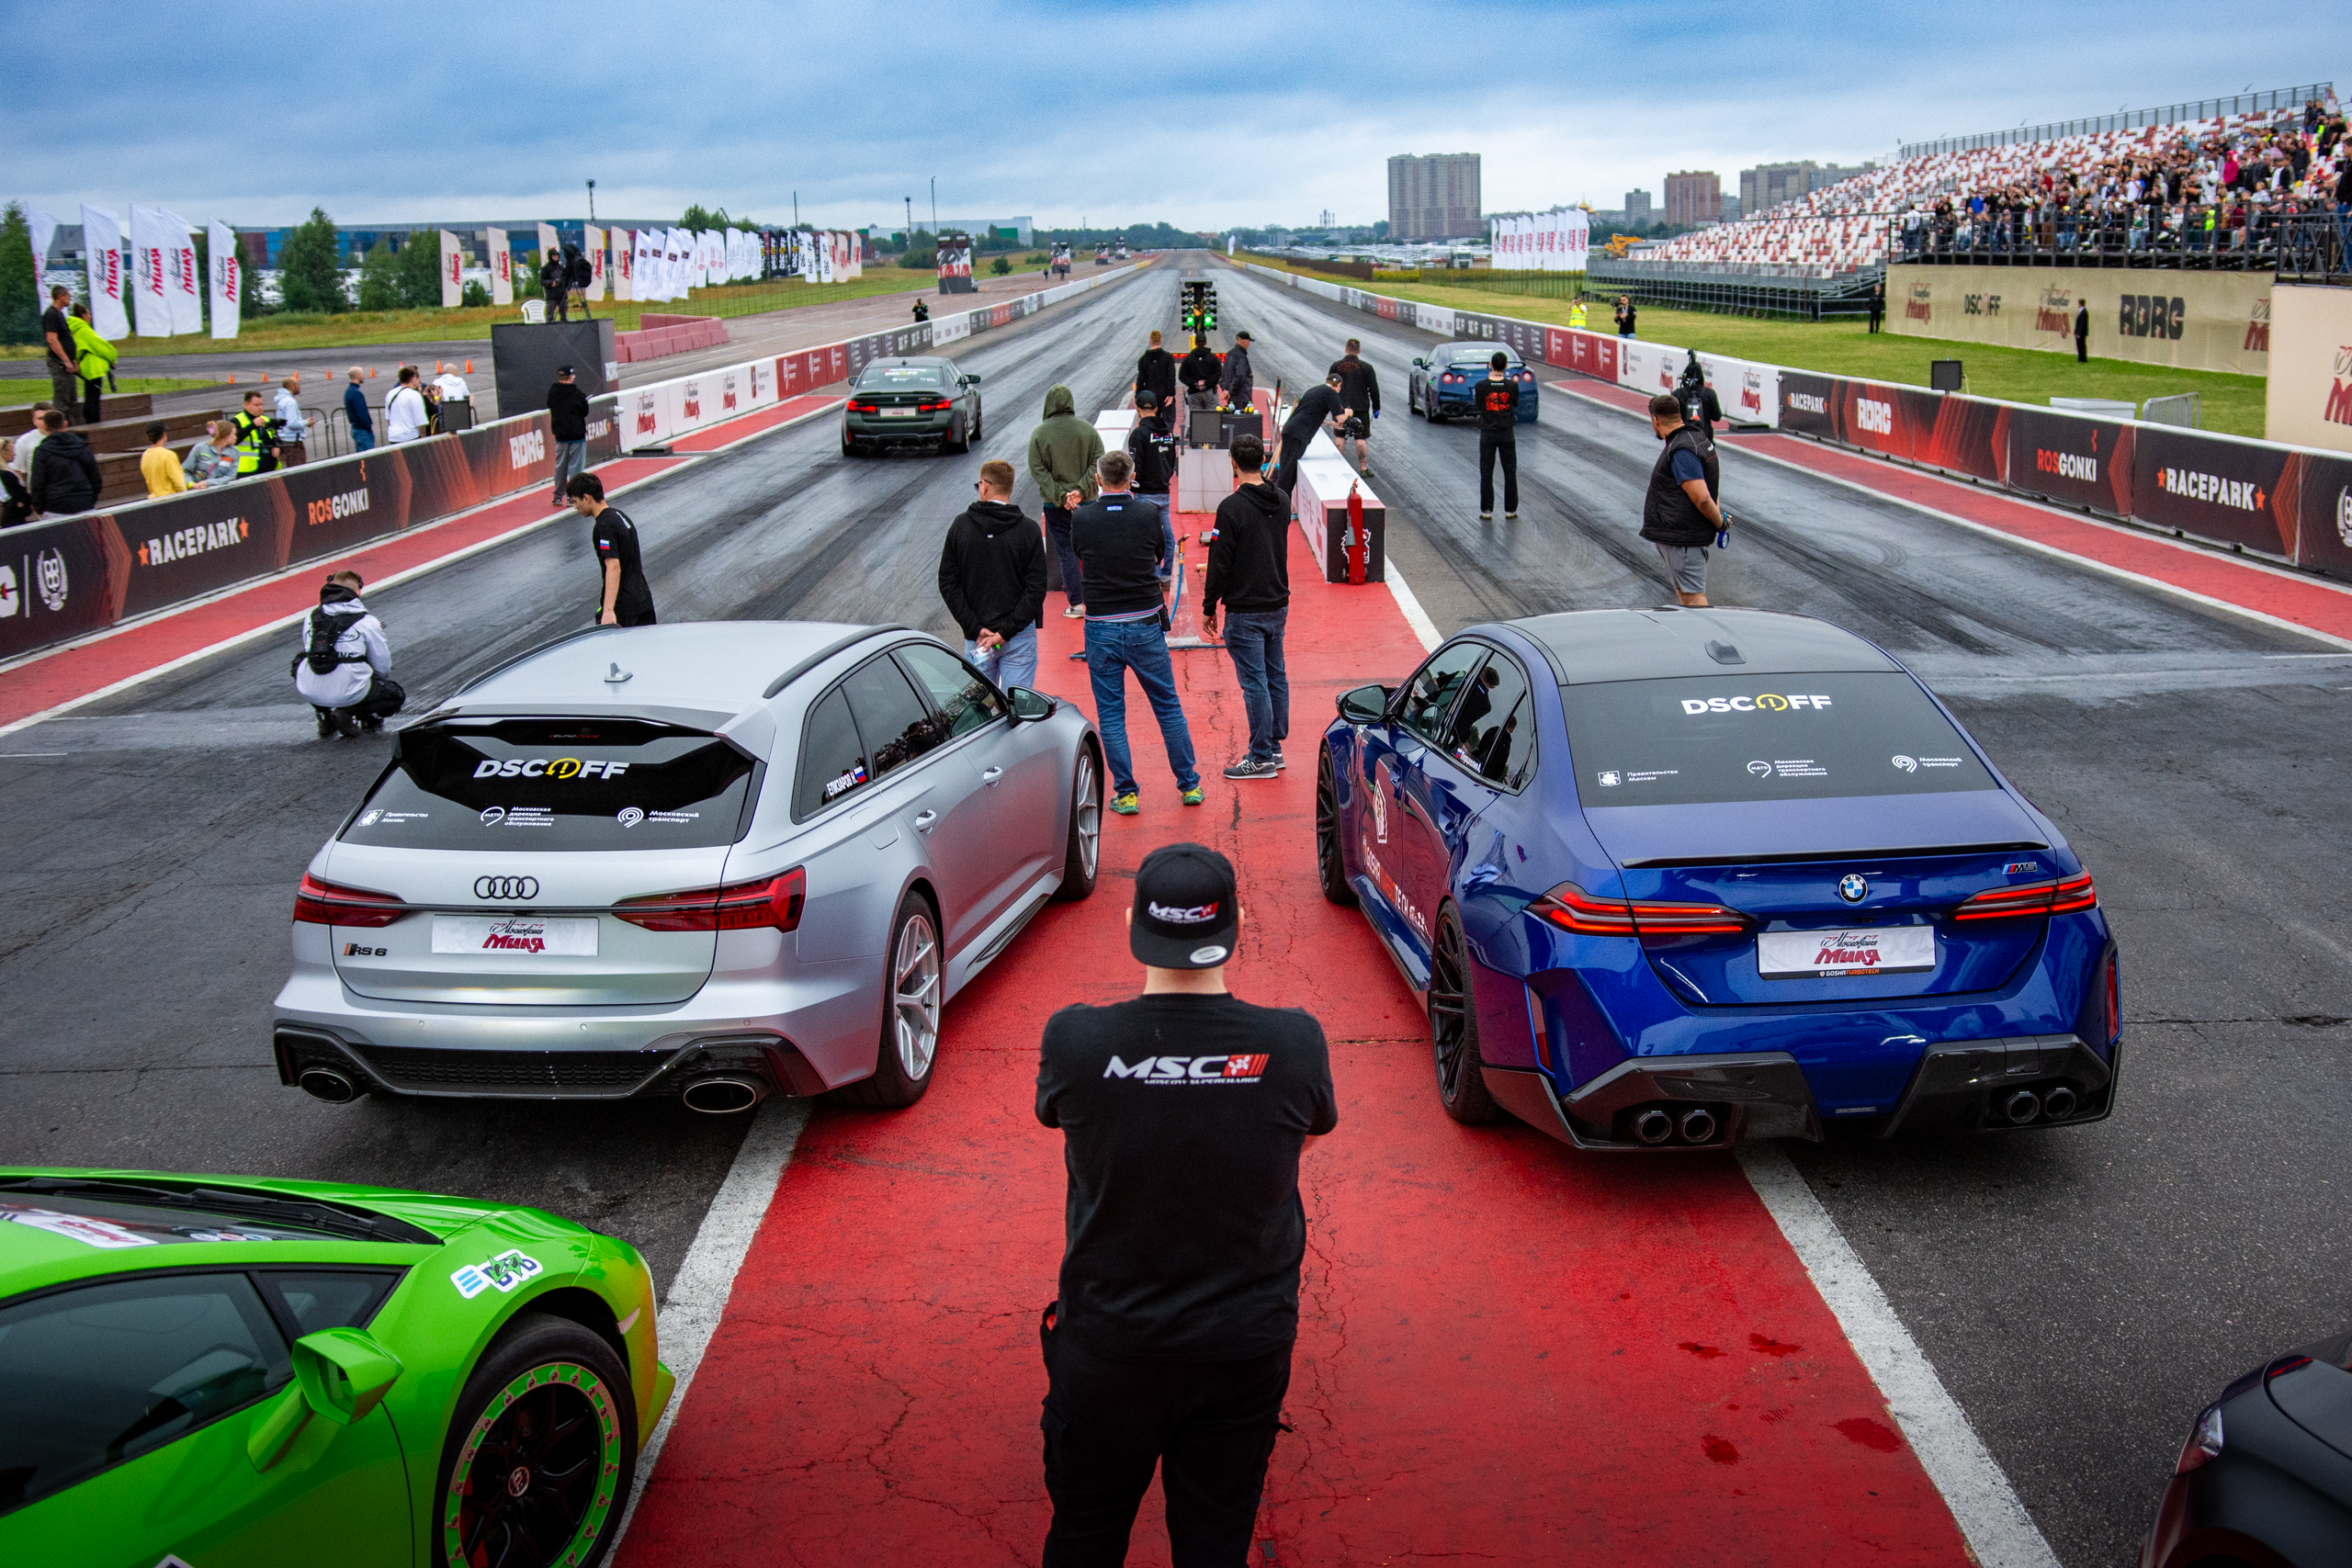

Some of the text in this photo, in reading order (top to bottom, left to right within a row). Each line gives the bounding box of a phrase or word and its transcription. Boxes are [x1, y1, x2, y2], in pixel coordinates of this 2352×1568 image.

[1791, 392, 1824, 414] RACEPARK
[2037, 448, 2097, 482] ROSGONKI
[2166, 468, 2256, 512] RACEPARK
[308, 488, 368, 525] ROSGONKI
[148, 517, 241, 566] RACEPARK
[1148, 901, 1204, 919] MSC
[482, 933, 546, 953] Миля
[1814, 948, 1882, 965] Миля
[1102, 1055, 1229, 1079] MSC
